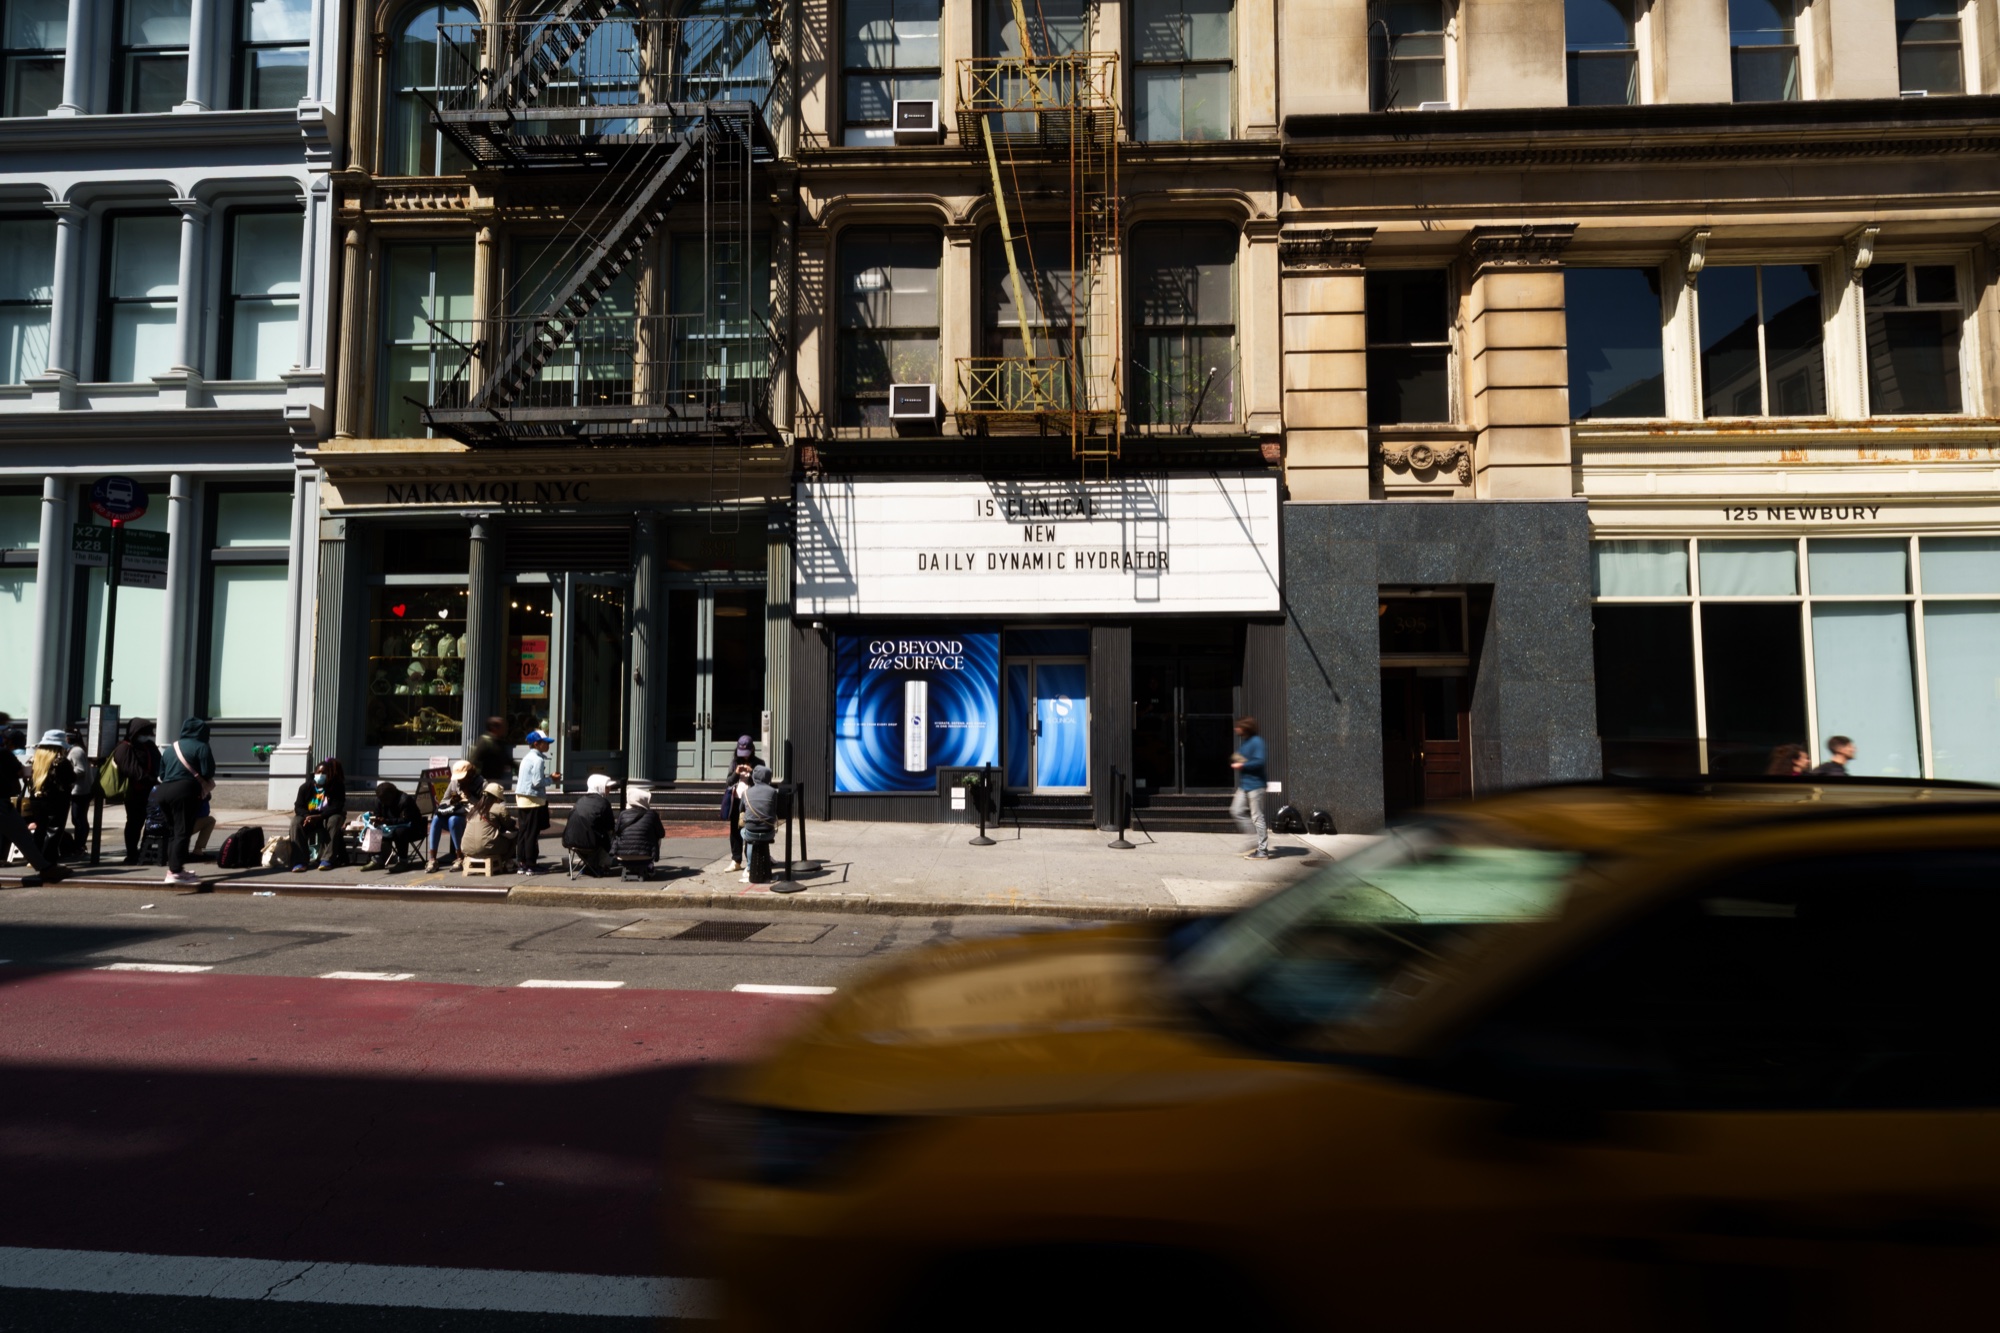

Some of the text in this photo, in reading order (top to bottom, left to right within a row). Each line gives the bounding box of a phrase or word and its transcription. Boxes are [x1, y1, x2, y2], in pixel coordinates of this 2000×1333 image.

[386, 482, 590, 503] NAKAMOL NYC
[977, 499, 1098, 517] IS CLINICAL
[1722, 506, 1880, 520] 125 NEWBURY
[1024, 525, 1055, 542] NEW
[918, 551, 1169, 570] DAILY DYNAMIC HYDRATOR
[1394, 616, 1426, 634] 395
[869, 640, 963, 655] GO BEYOND
[868, 654, 965, 670] the SURFACE
